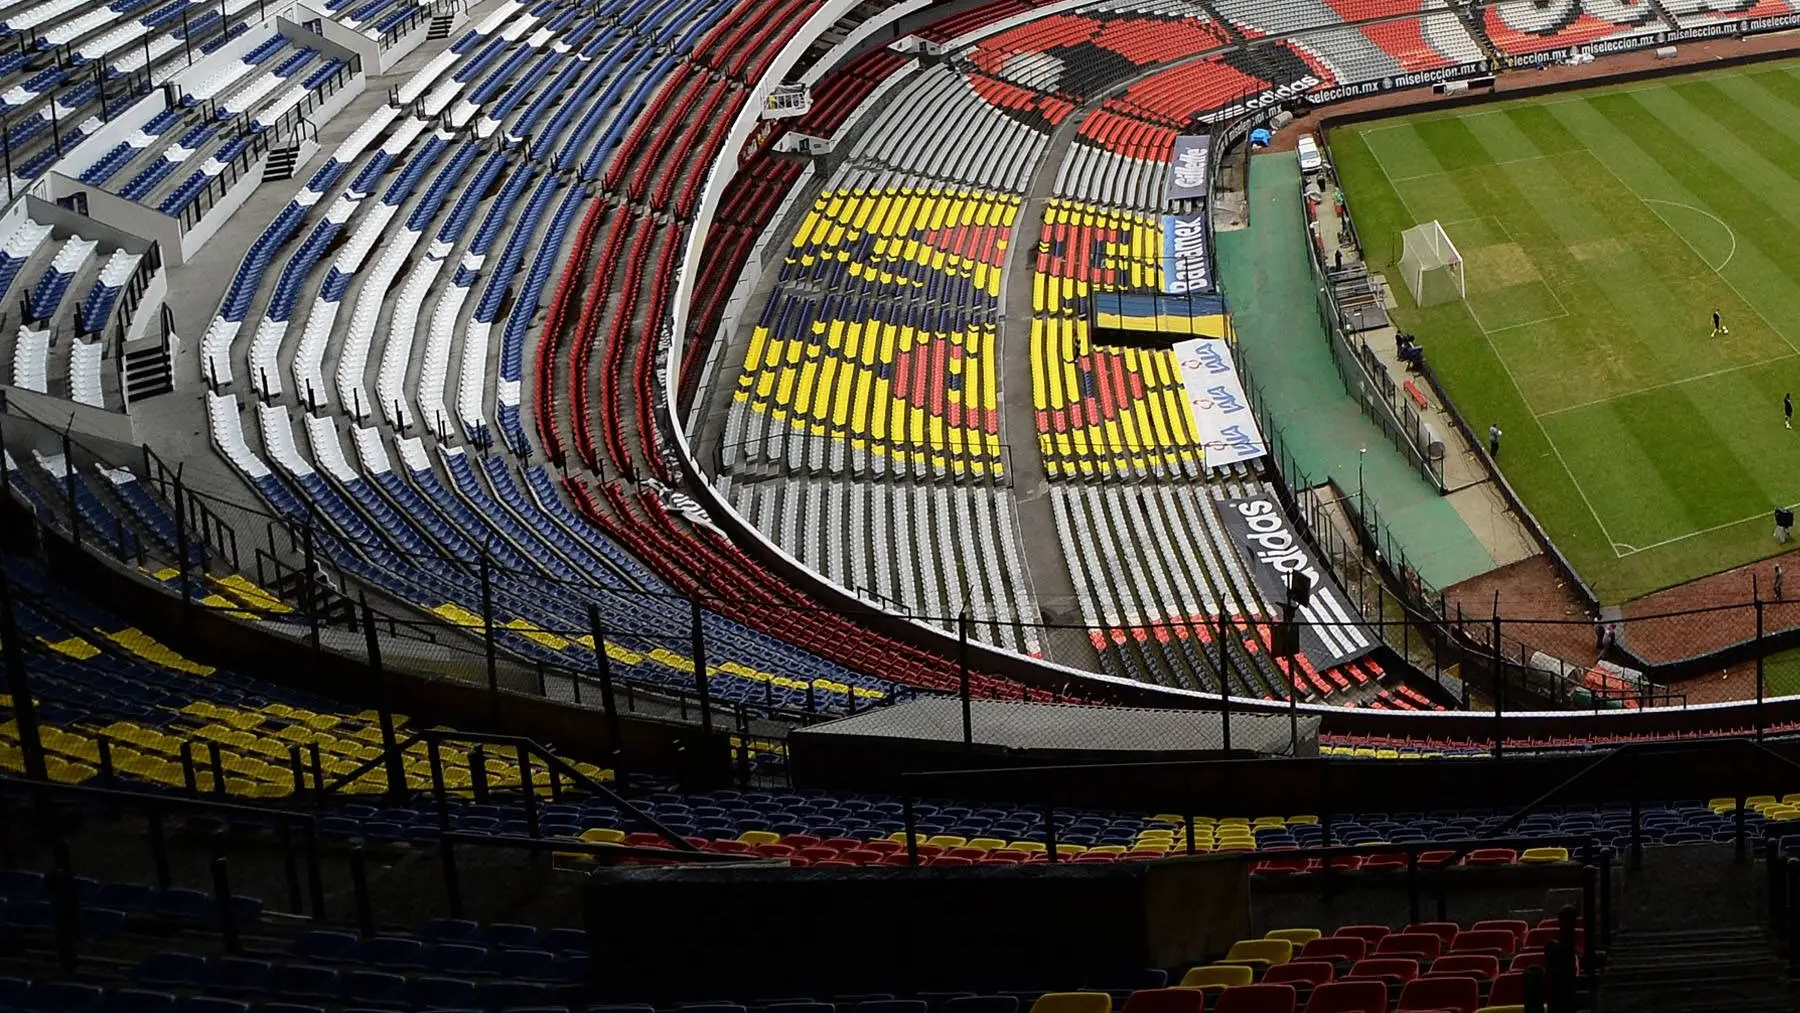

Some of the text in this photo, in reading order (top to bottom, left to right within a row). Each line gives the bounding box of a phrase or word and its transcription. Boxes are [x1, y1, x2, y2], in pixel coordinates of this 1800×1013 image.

[1667, 24, 1738, 41] miseleccion.mx
[1395, 64, 1476, 88] miseleccion.mx
[1174, 148, 1208, 188] Gillette
